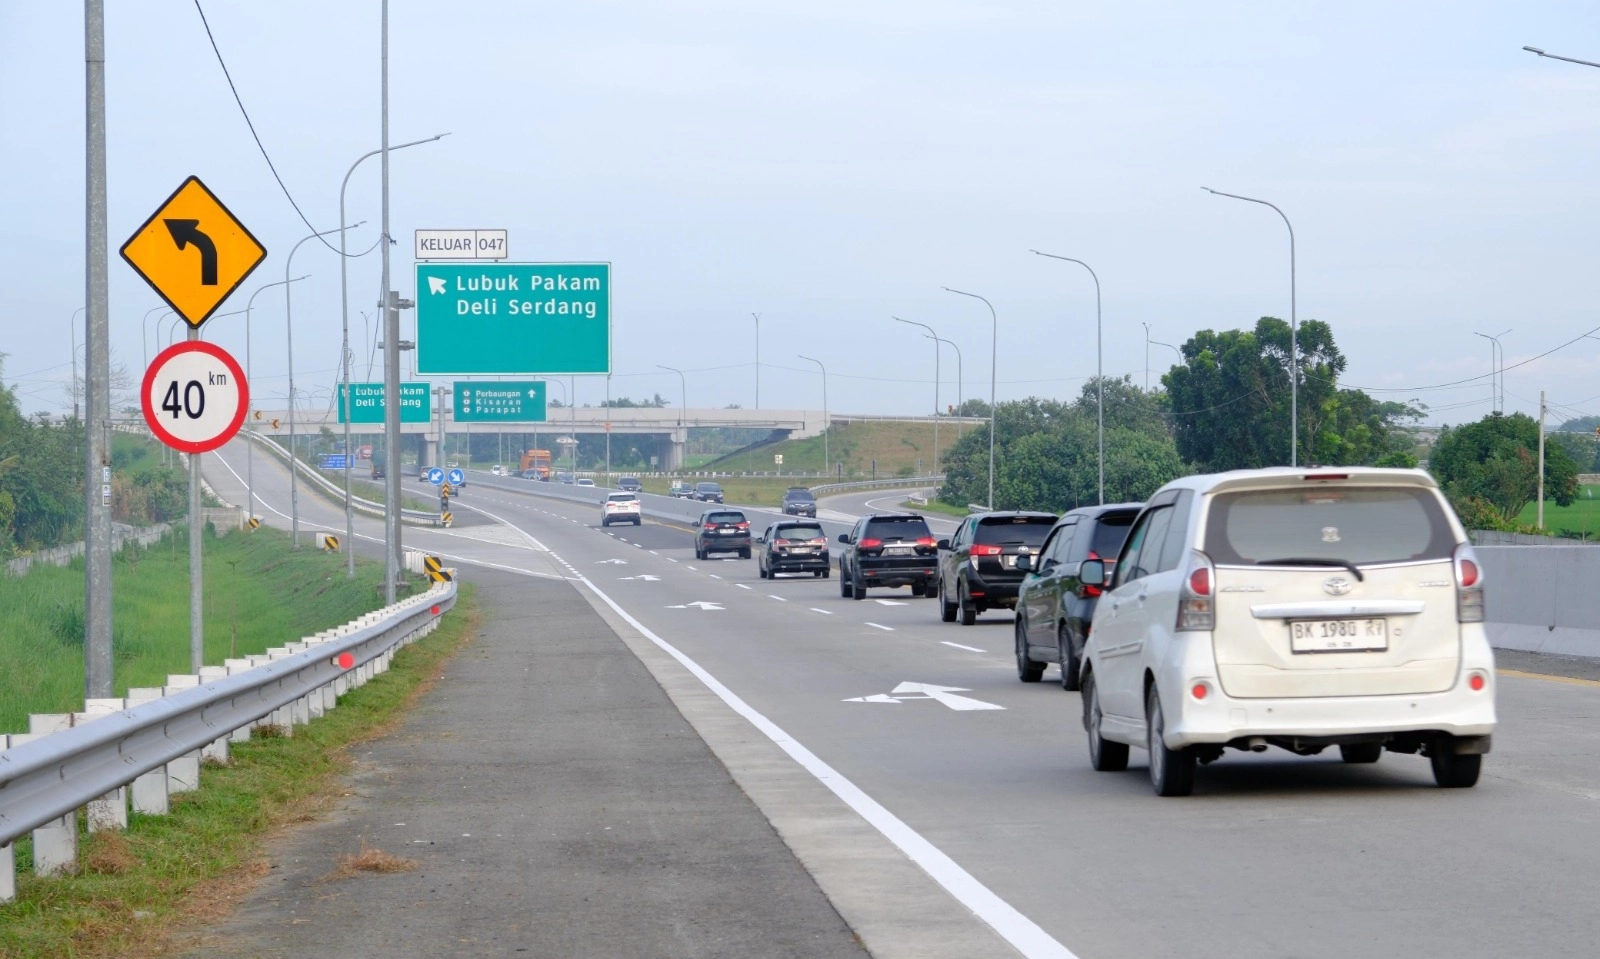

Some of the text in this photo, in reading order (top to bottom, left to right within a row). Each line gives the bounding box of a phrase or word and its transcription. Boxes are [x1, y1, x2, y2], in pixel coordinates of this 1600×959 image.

[420, 238, 505, 251] KELUAR 047
[457, 274, 601, 291] Lubuk Pakam
[457, 298, 597, 318] Deli Serdang
[161, 371, 227, 419] 40 km
[355, 387, 424, 396] Lubuk kam
[475, 390, 521, 398] Perbaungan
[356, 398, 375, 407] Deli
[476, 406, 521, 414] Parapat
[1294, 623, 1314, 639] BK
